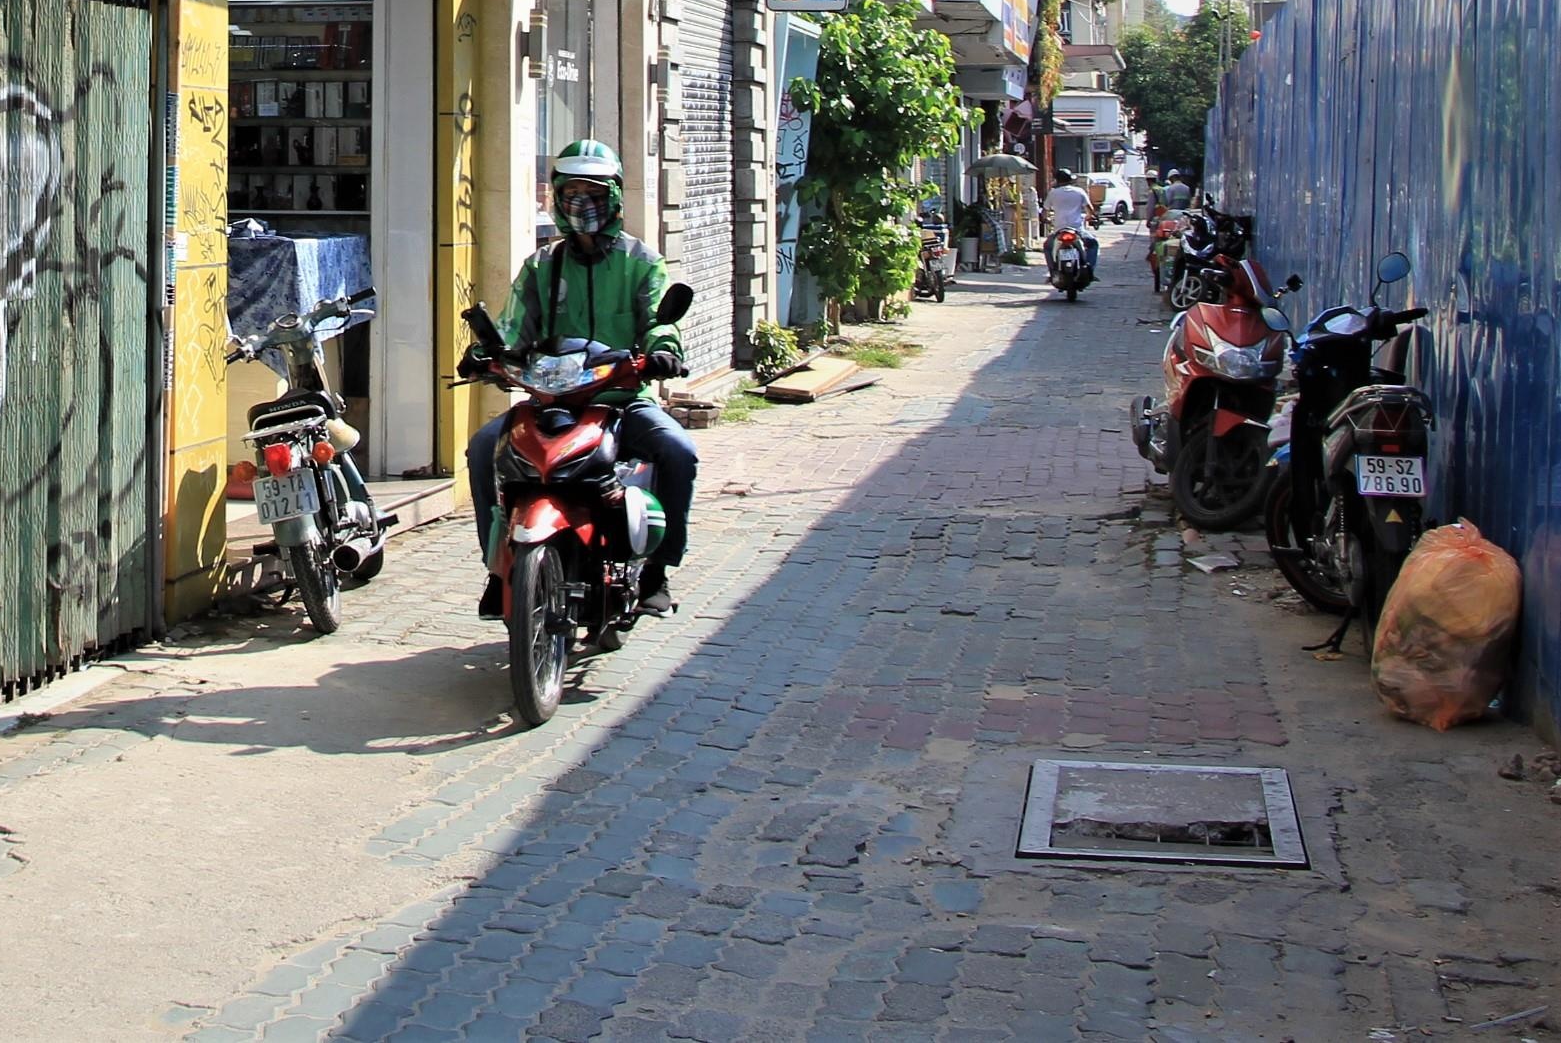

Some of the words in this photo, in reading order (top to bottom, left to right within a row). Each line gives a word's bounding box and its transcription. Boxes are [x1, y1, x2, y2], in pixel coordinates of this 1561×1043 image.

[268, 399, 308, 413] HONDA
[1366, 457, 1416, 476] 59-S2
[262, 473, 307, 499] 59-TA
[1362, 475, 1423, 494] 786.90
[260, 491, 315, 520] 012.41
